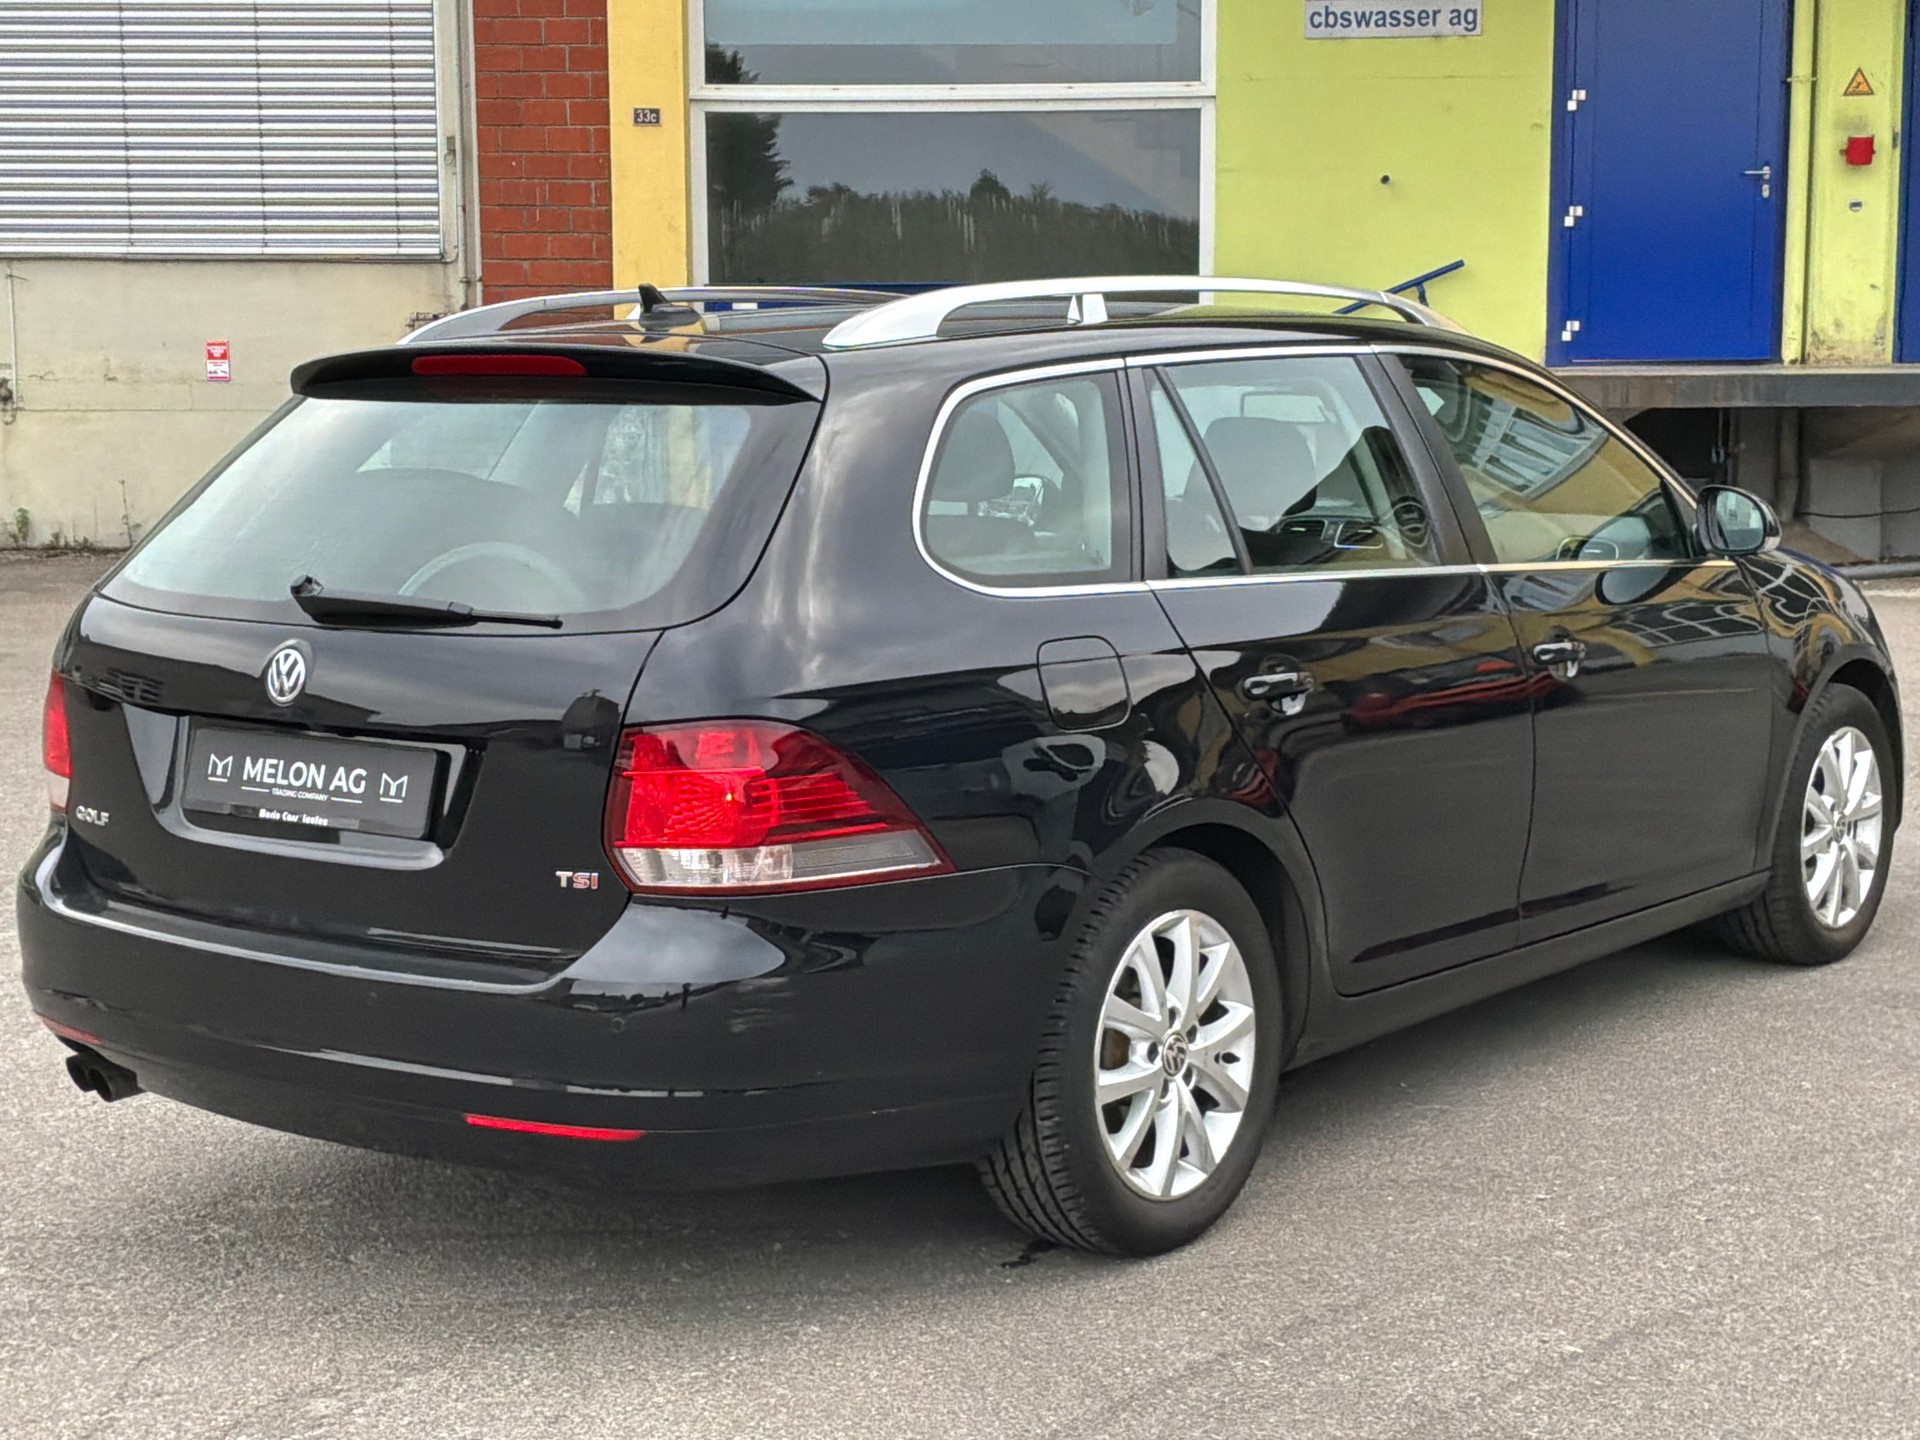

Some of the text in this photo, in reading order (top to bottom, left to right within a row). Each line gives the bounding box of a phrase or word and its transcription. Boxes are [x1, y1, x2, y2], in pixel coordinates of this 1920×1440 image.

[1309, 5, 1478, 32] cbswasser ag
[636, 109, 657, 123] 33c
[242, 756, 368, 794] MELON AG
[271, 787, 329, 802] TRADING COMPANY
[75, 804, 110, 827] GOLF
[555, 870, 599, 890] TSI
